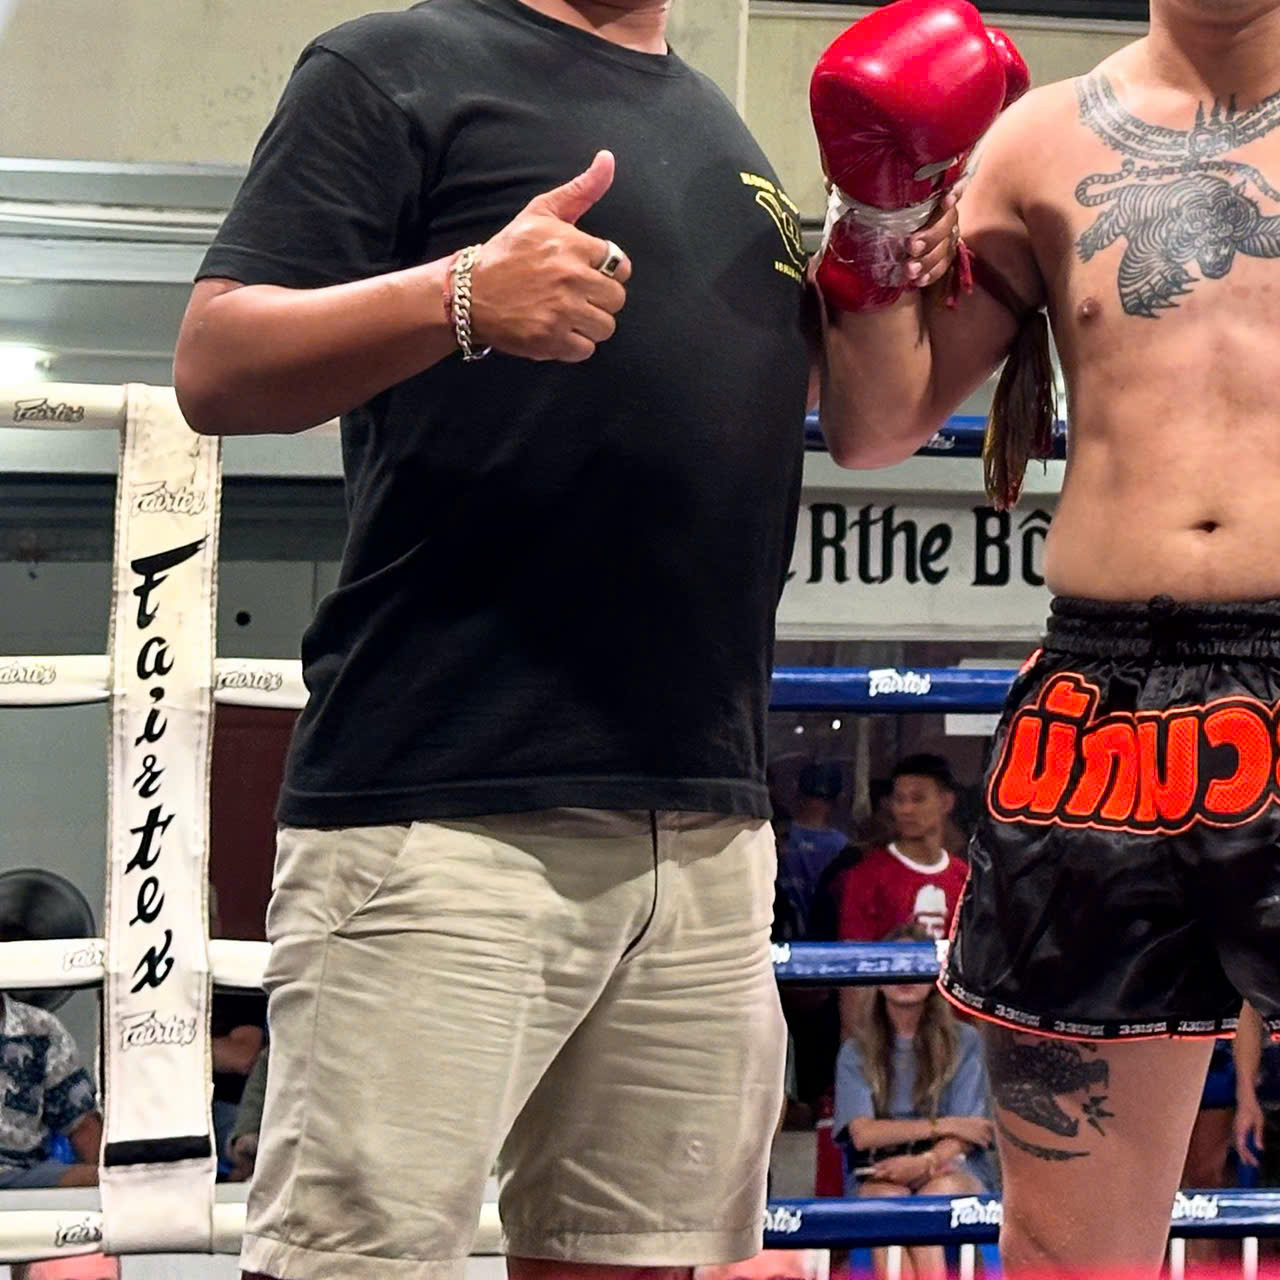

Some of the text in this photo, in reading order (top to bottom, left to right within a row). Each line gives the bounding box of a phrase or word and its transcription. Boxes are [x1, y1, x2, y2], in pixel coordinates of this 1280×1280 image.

[129, 481, 208, 517] Fairtex
[786, 502, 953, 586] Rthe
[0, 661, 56, 685] airtex
[868, 668, 932, 697] Fairtex
[125, 534, 210, 994] Fairtex
[120, 1010, 197, 1051] Fairtex
